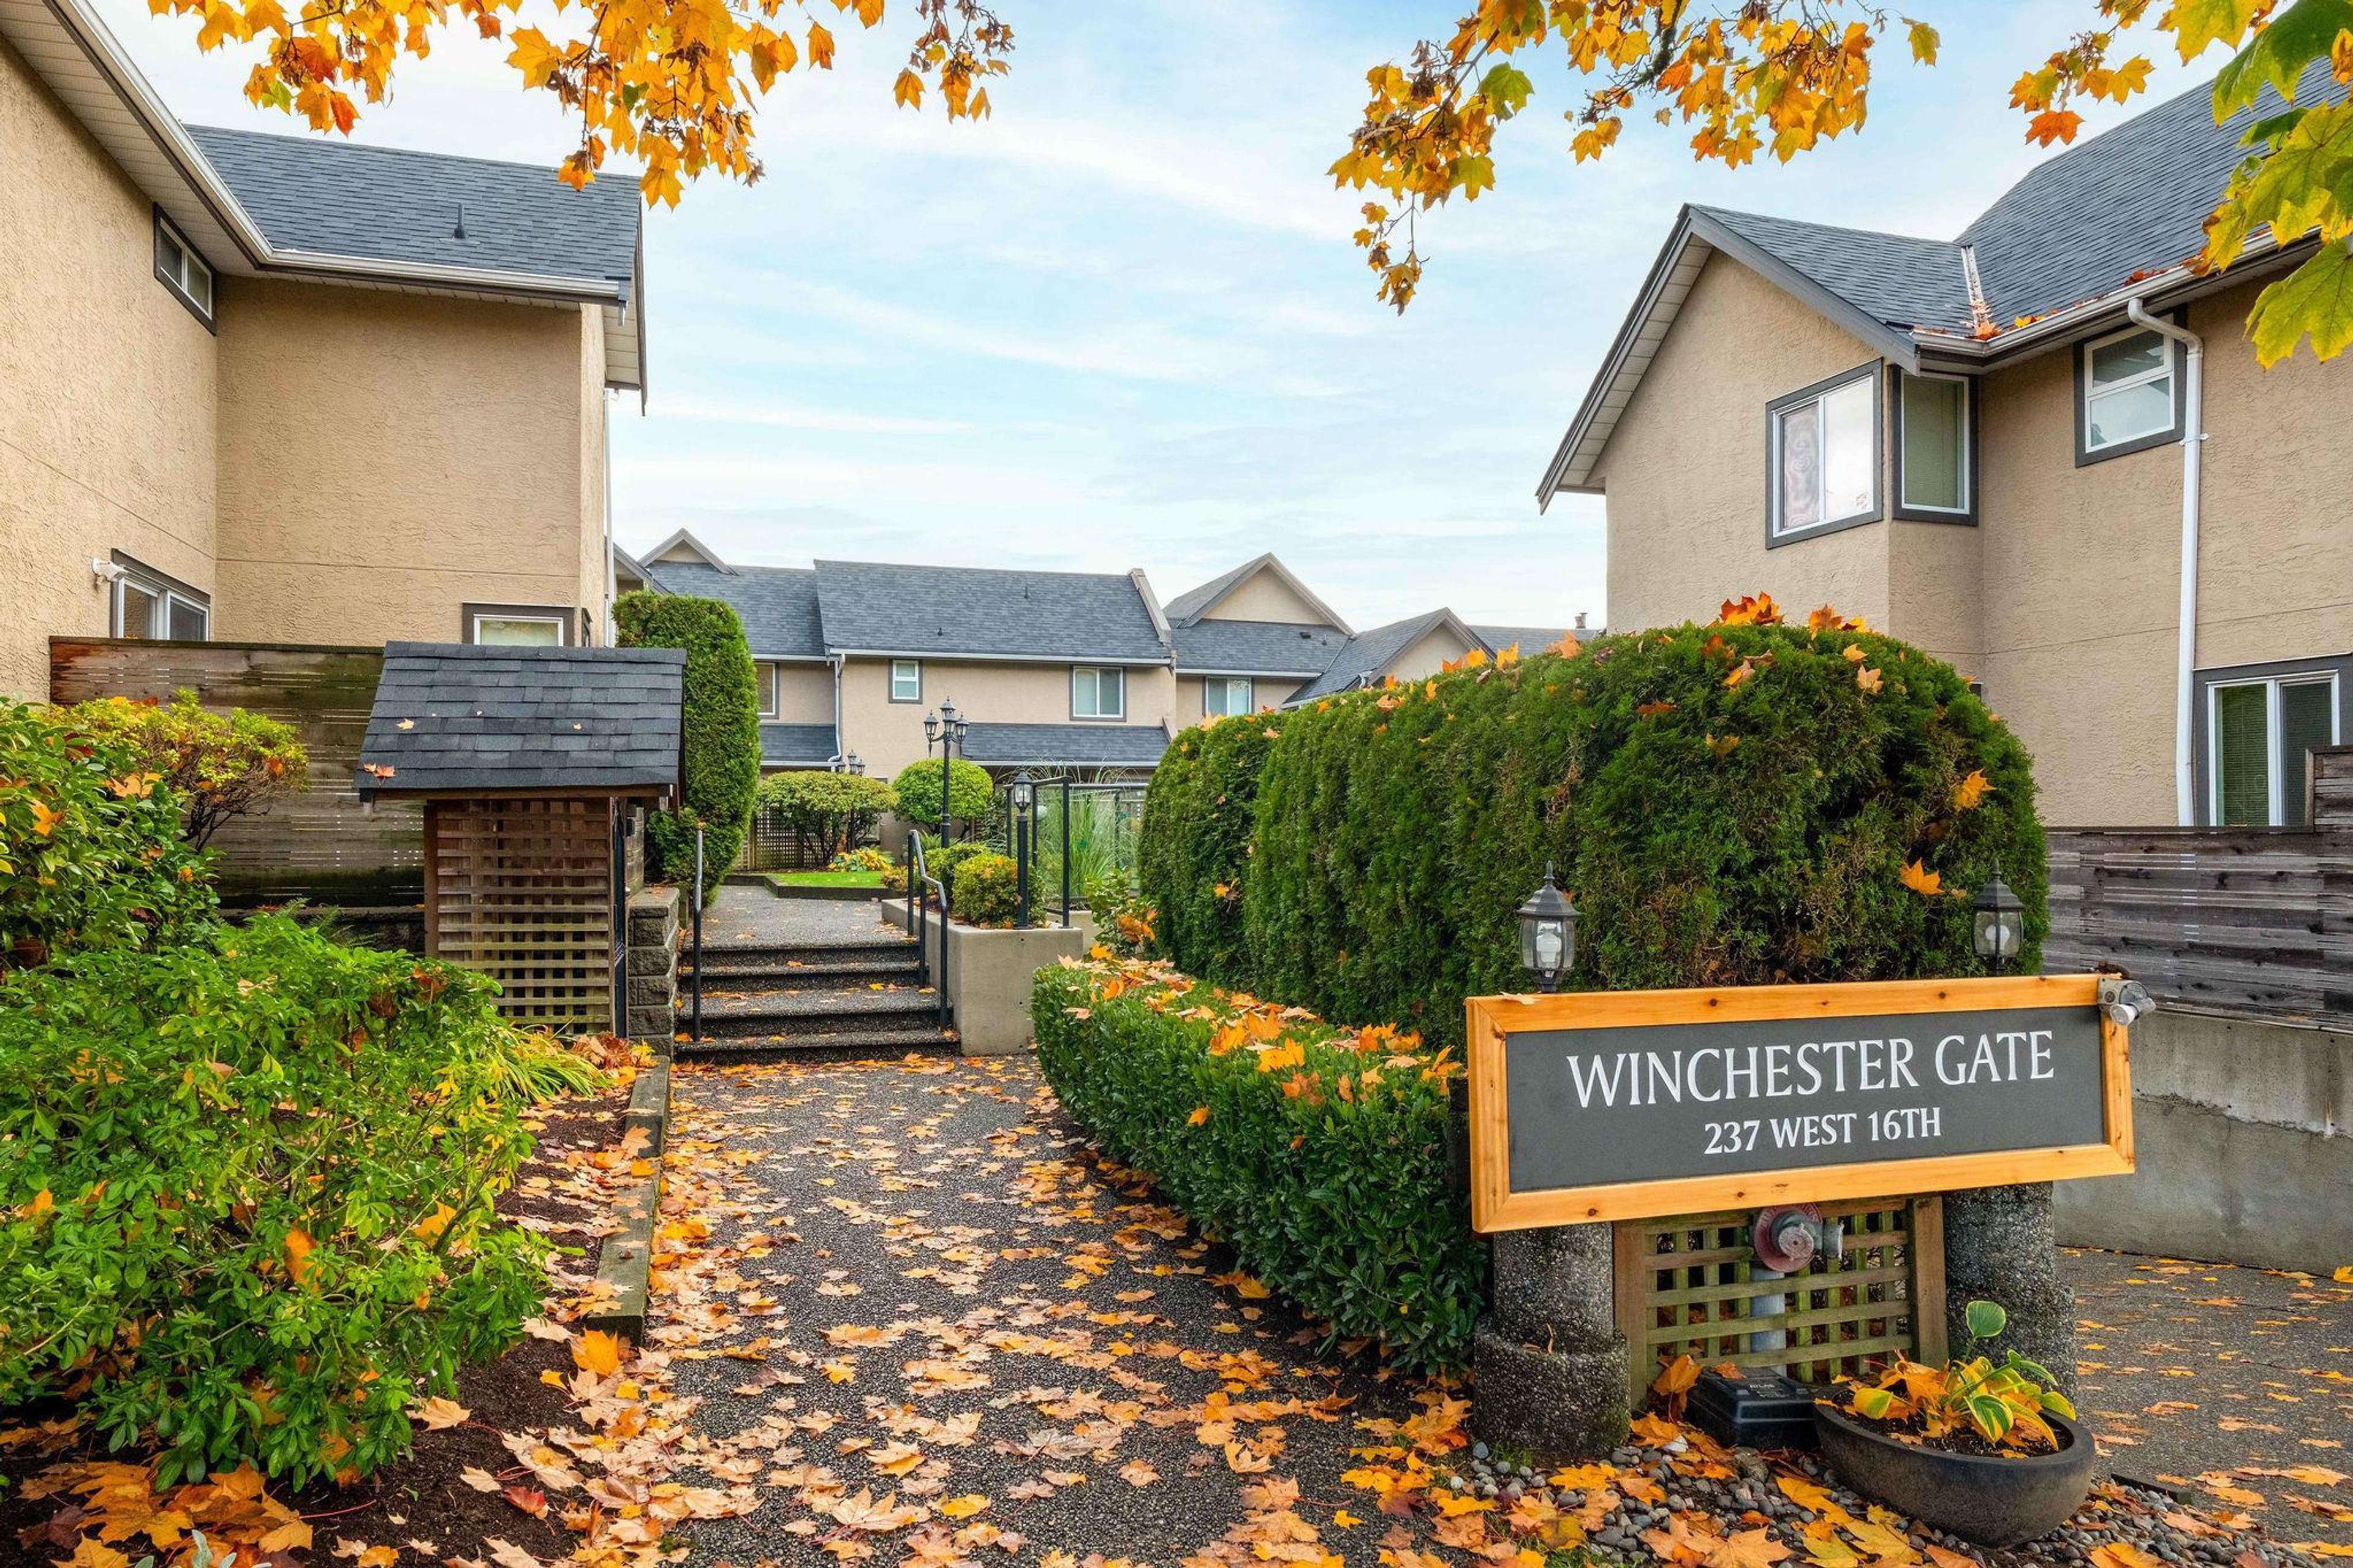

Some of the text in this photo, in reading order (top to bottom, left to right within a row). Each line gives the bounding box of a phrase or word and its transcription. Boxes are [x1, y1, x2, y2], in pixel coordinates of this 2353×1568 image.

[1566, 1030, 2055, 1108] WINCHESTER GATE
[1704, 1107, 1941, 1154] 237 WEST 16TH
